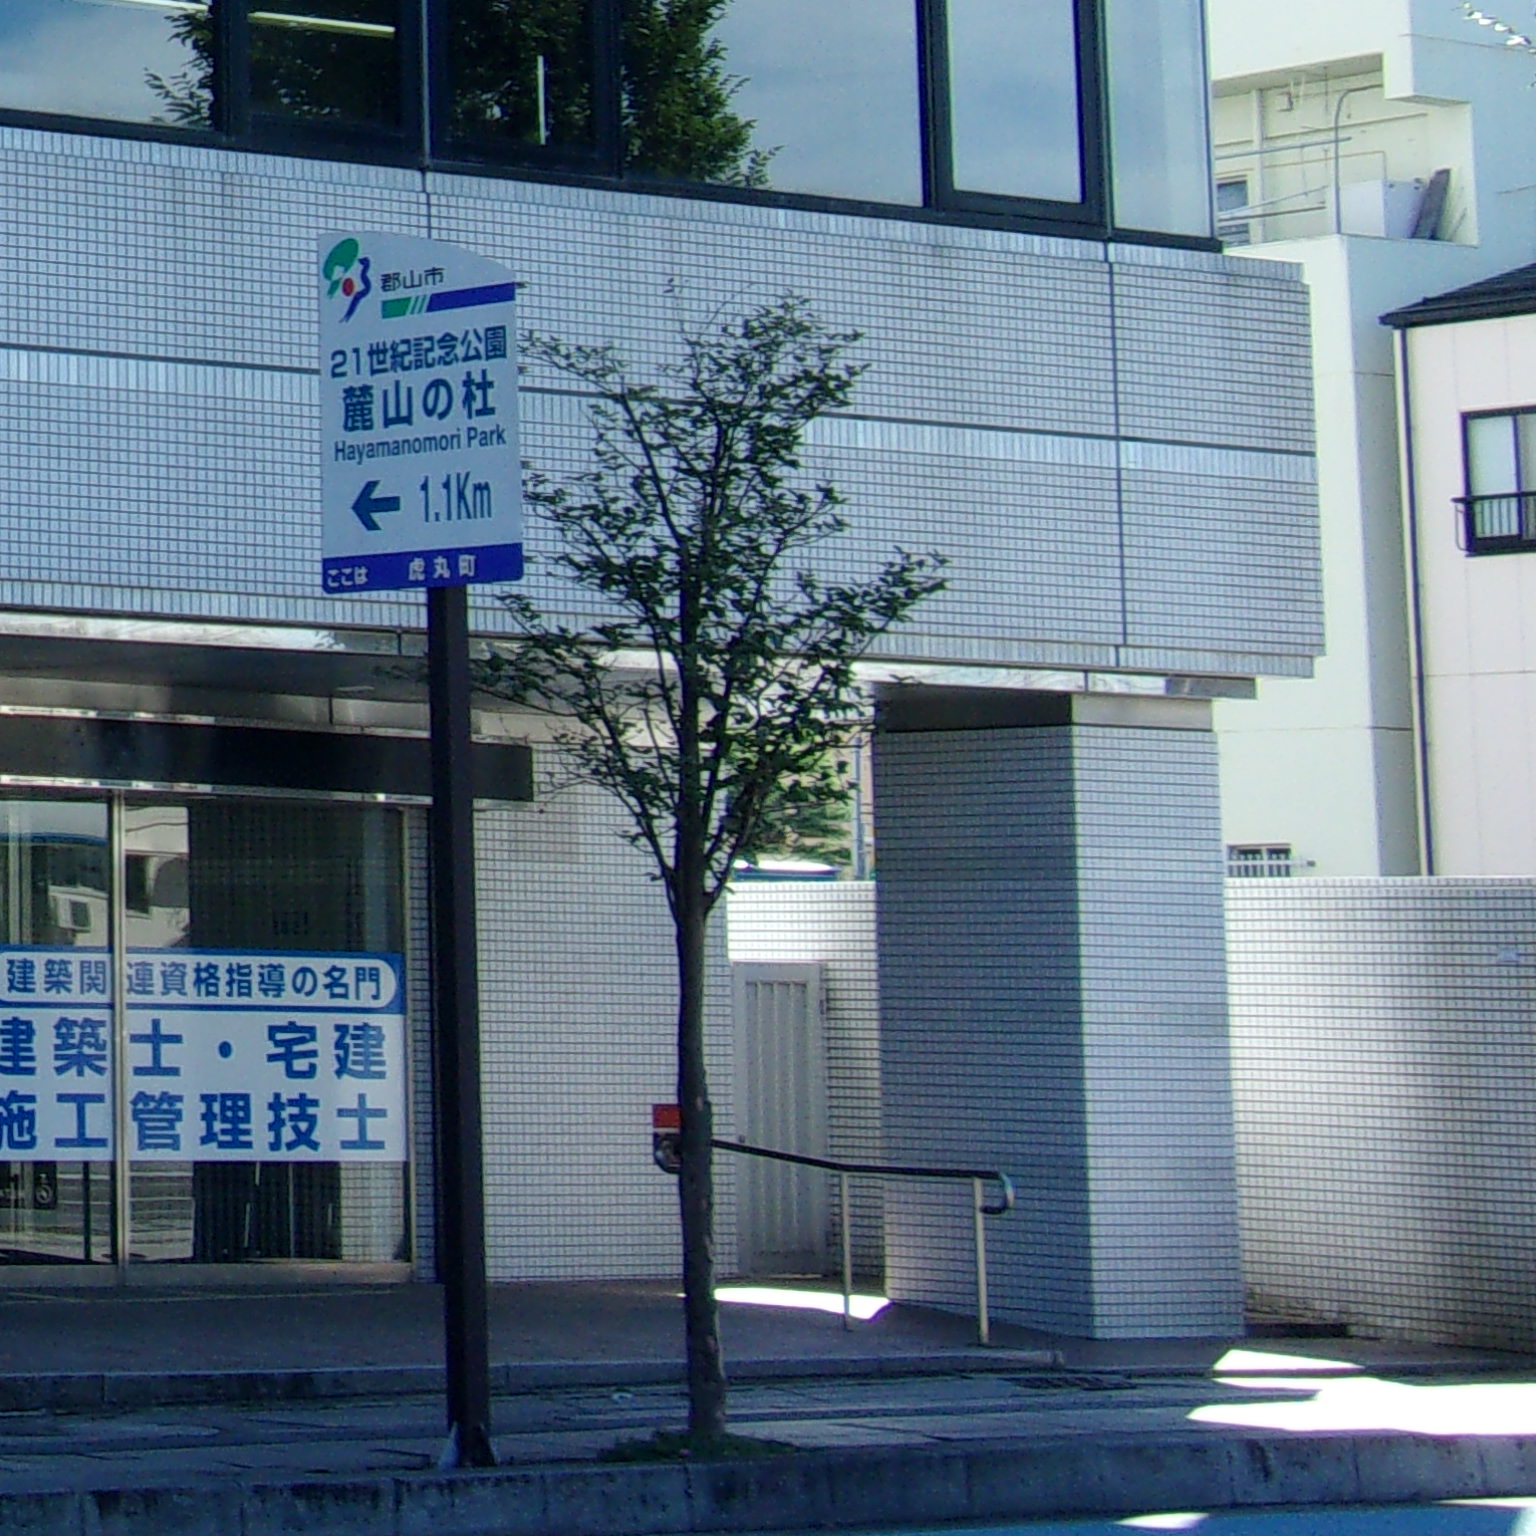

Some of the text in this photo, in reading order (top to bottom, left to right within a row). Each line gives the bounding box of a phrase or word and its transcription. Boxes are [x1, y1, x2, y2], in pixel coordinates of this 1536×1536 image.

[380, 267, 445, 293] 郡山市
[330, 325, 507, 379] 21世紀記念公園
[342, 368, 496, 433] 麓山の杜
[334, 423, 506, 465] Hayamanomori Park
[419, 470, 492, 523] 1.1Km
[327, 553, 477, 588] ここは 虎丸町
[5, 958, 382, 1002] 建築関連資格指導の名門
